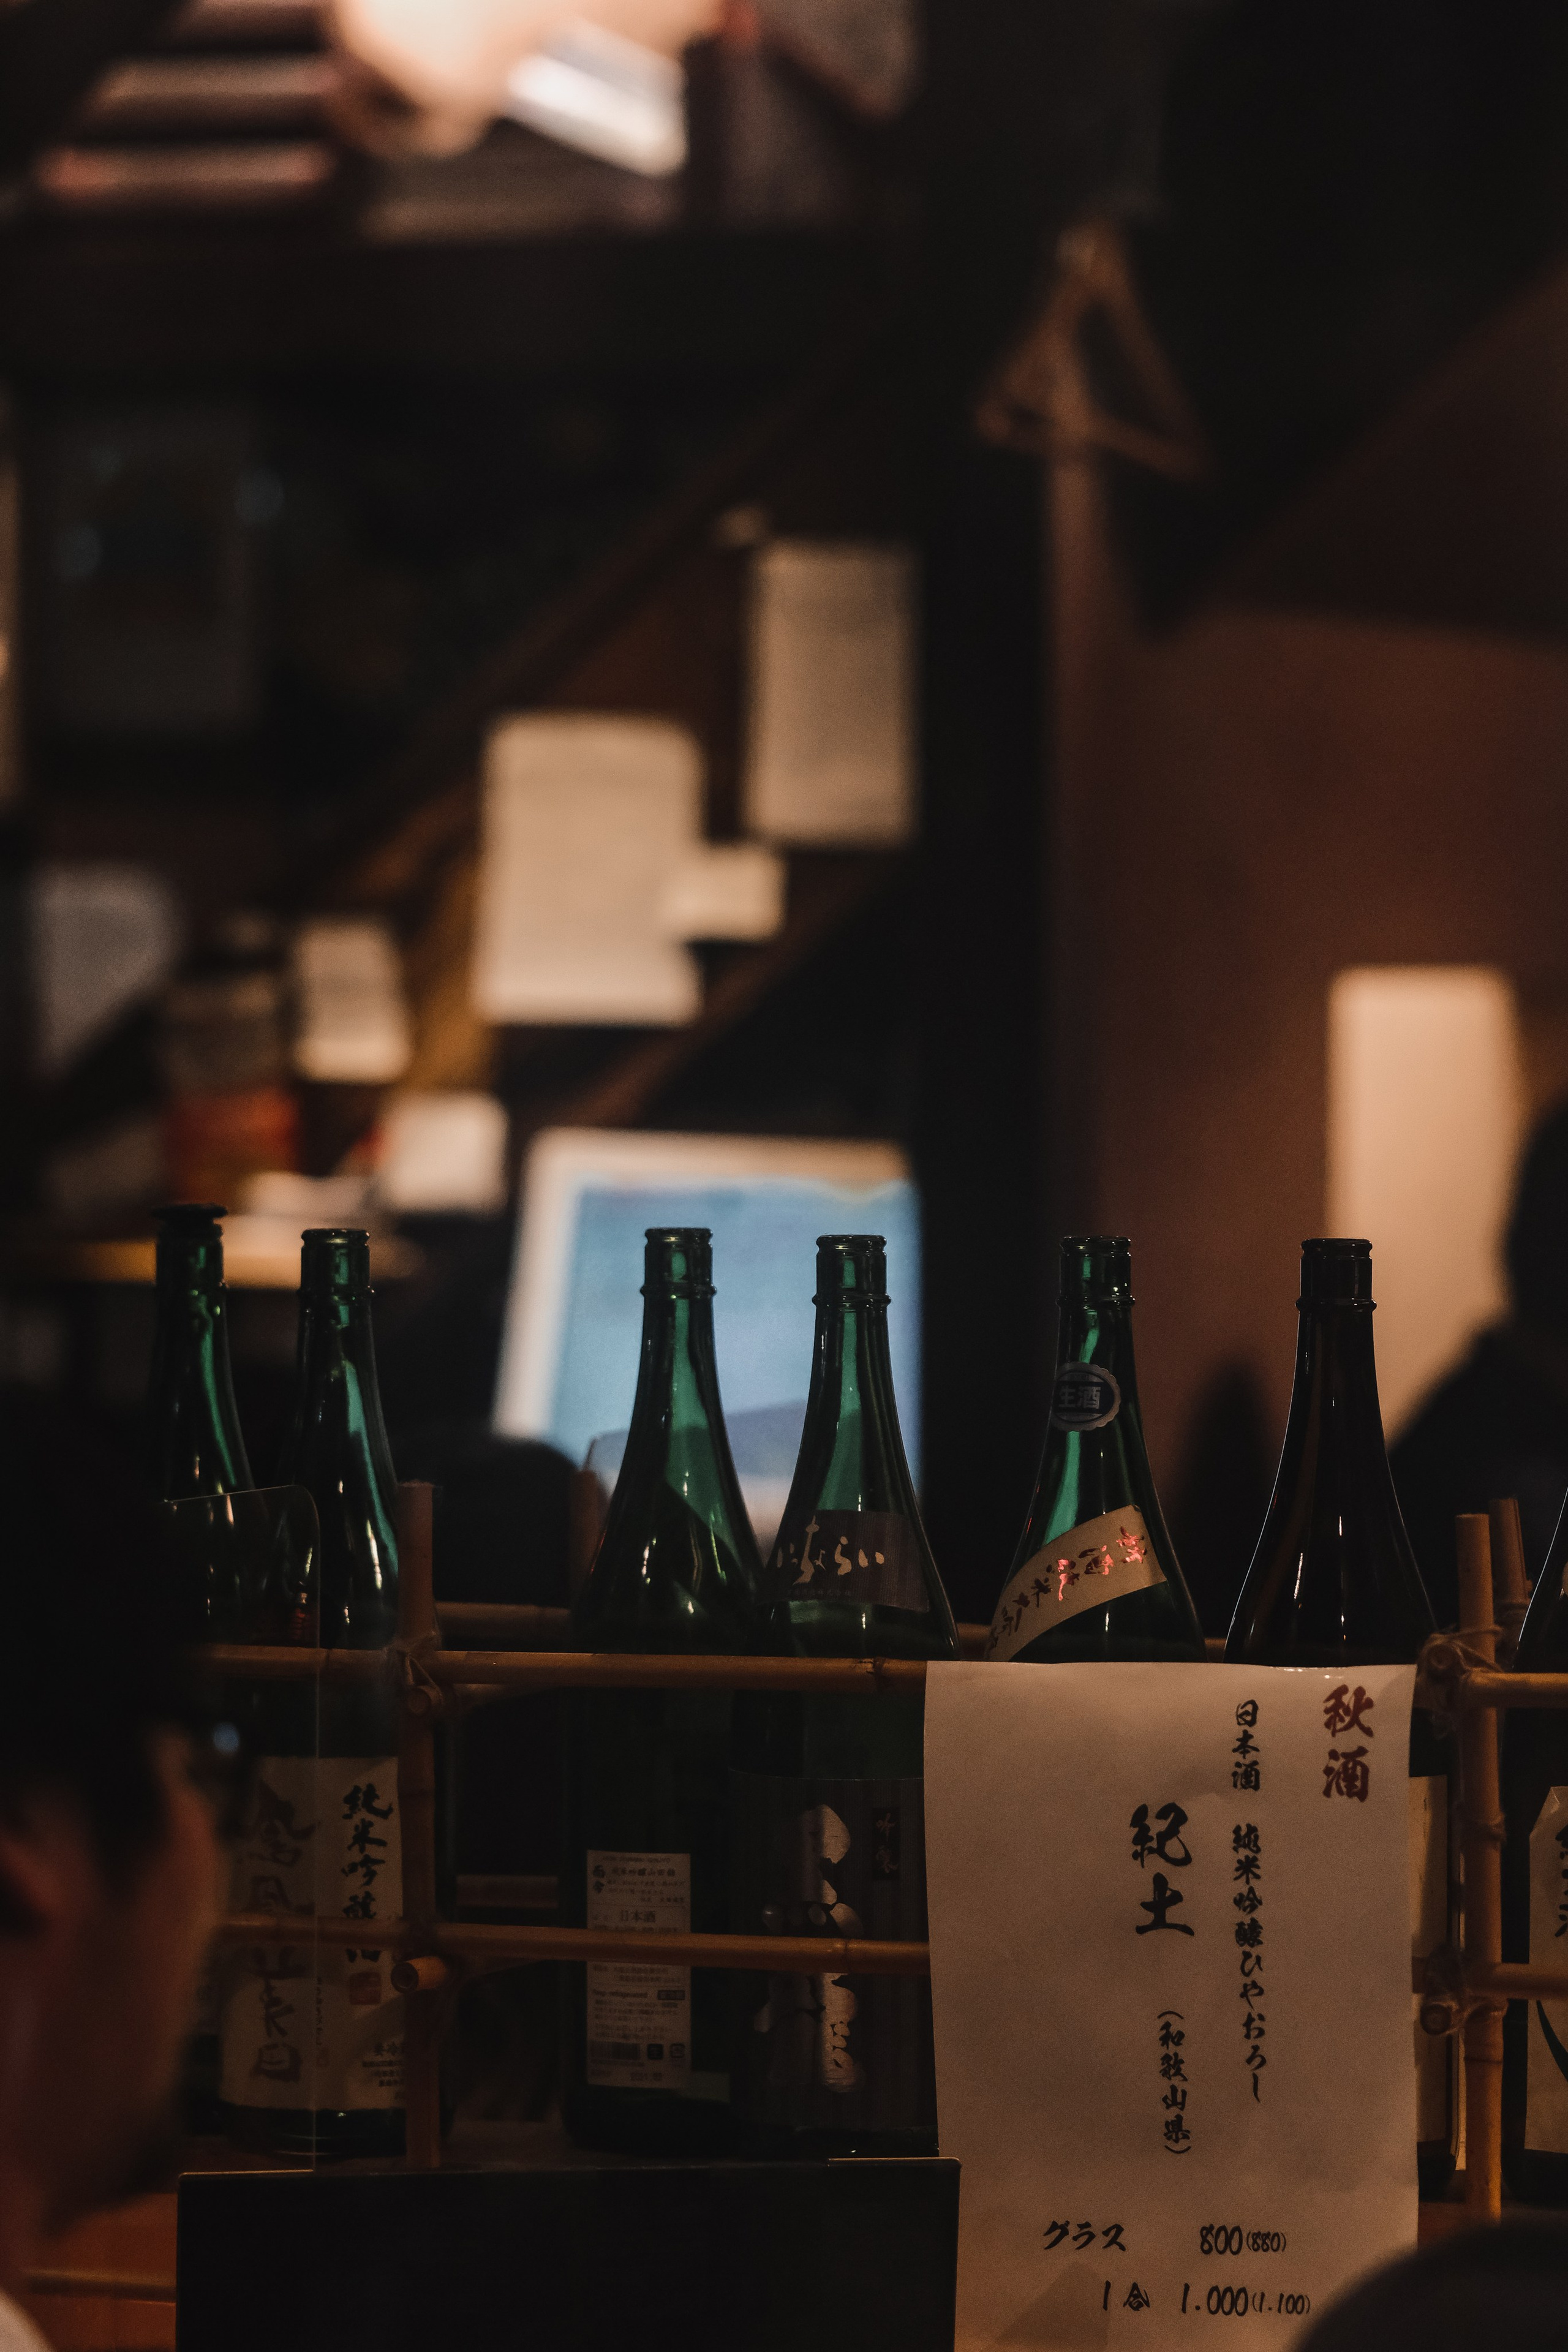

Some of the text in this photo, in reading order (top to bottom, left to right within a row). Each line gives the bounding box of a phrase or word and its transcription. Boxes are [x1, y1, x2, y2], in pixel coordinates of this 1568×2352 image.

[1058, 1385, 1101, 1409] 生酒
[1322, 1685, 1374, 1803] 秋酒
[620, 1910, 655, 1922] 日本酒
[1129, 1802, 1194, 1937] 紀土
[1231, 1700, 1267, 2103] 日本酒 純米吟醸ひやおろし
[1158, 2011, 1191, 2154] (和歌山県)
[1043, 2220, 1126, 2252] グラス
